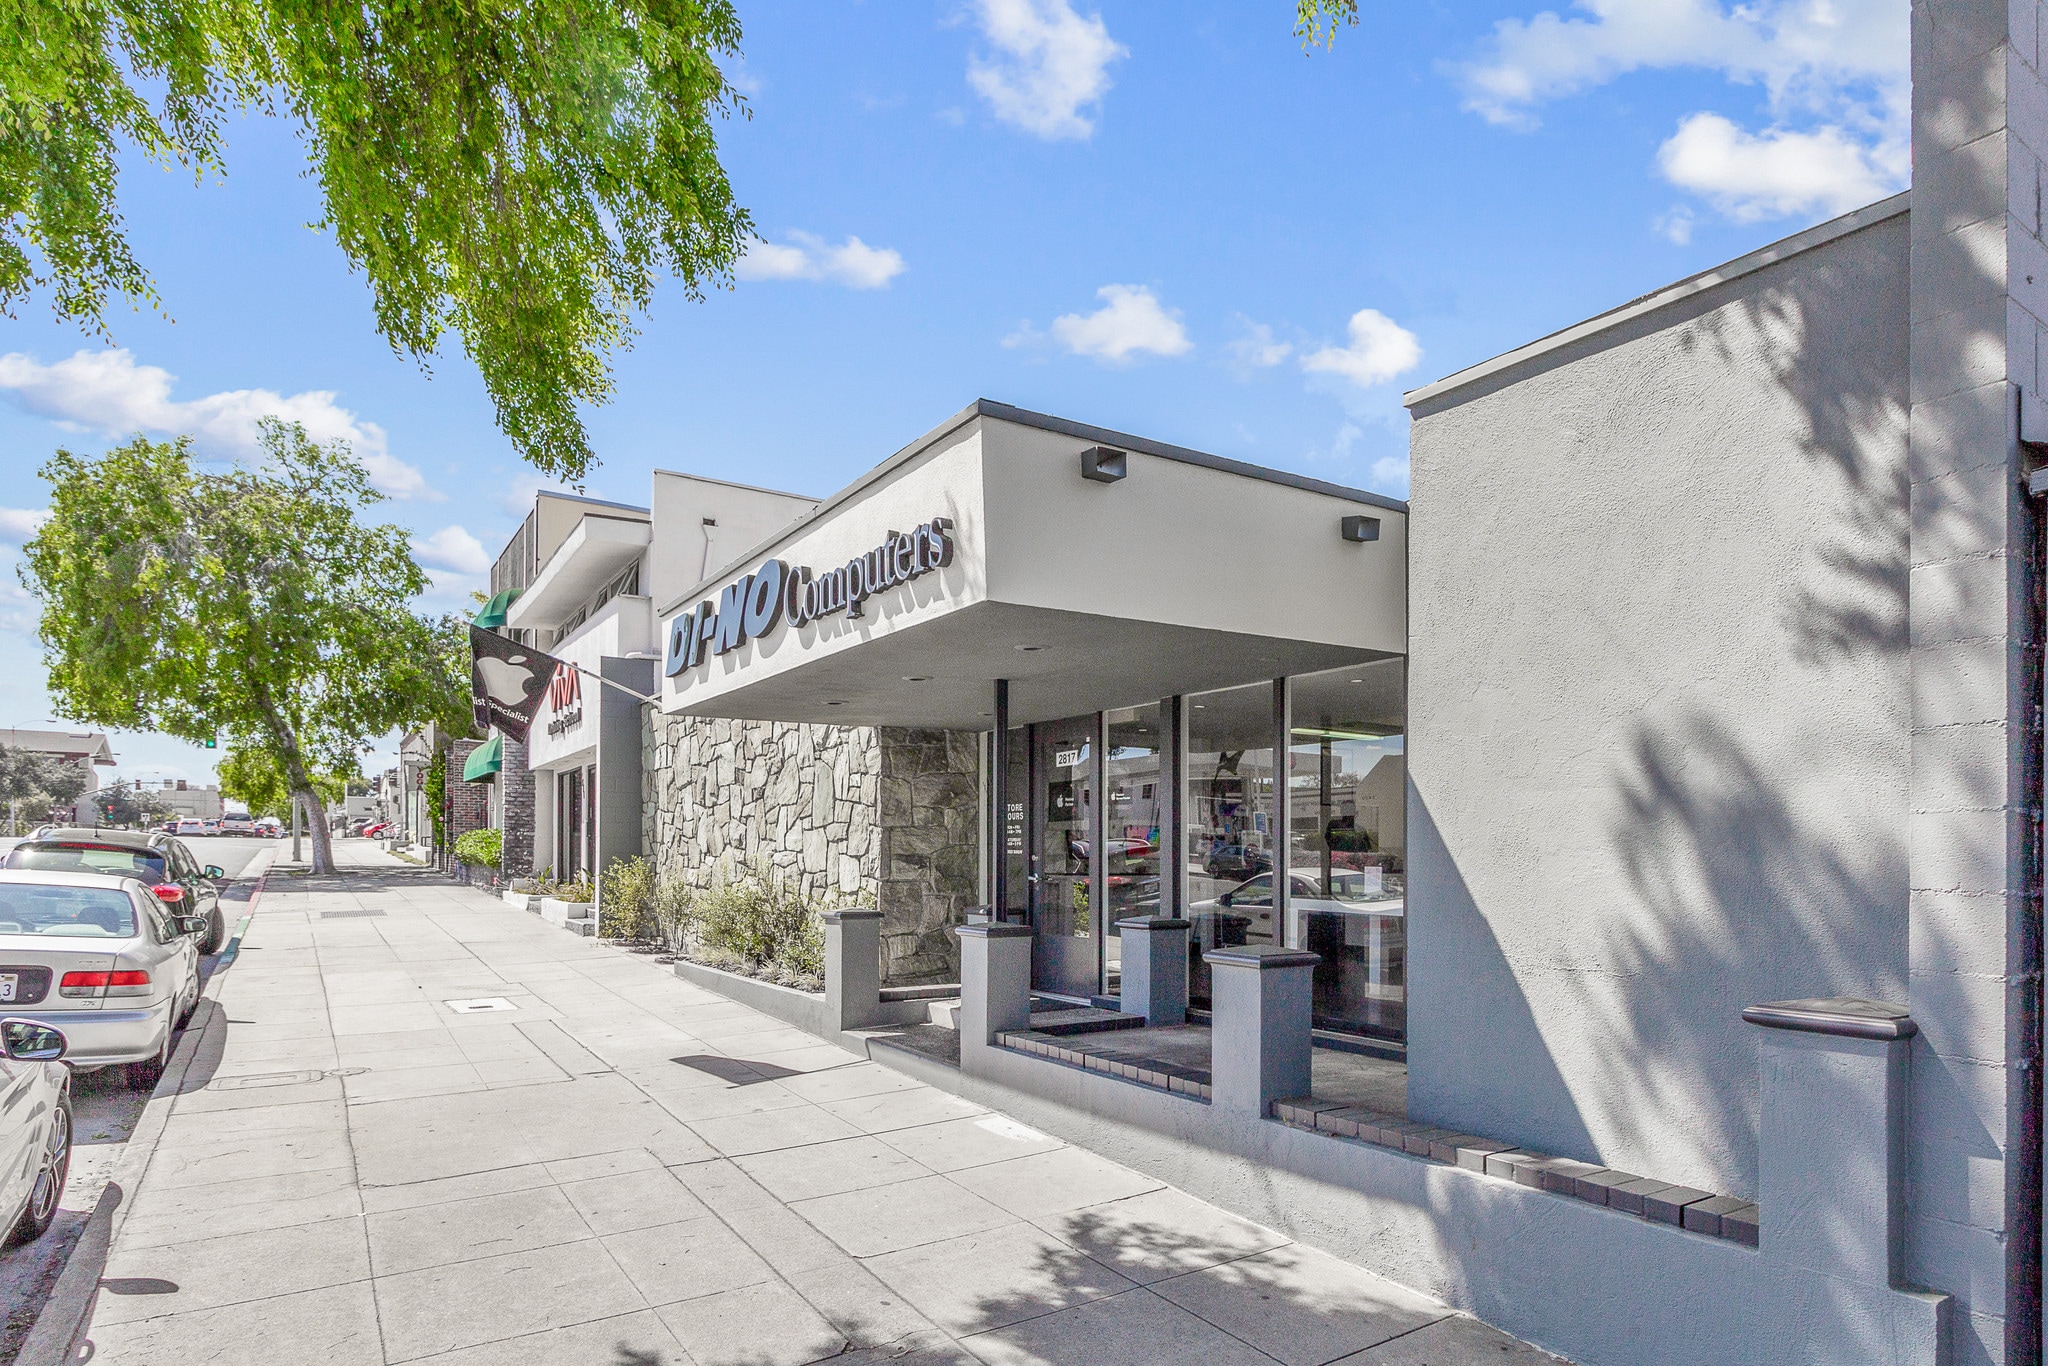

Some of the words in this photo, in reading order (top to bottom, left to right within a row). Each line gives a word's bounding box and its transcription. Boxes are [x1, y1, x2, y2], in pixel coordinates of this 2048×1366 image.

[665, 559, 788, 677] DI-NO
[784, 517, 953, 628] Computers
[1058, 752, 1076, 765] 2817
[1007, 803, 1023, 812] TORE
[1007, 812, 1024, 820] OURS
